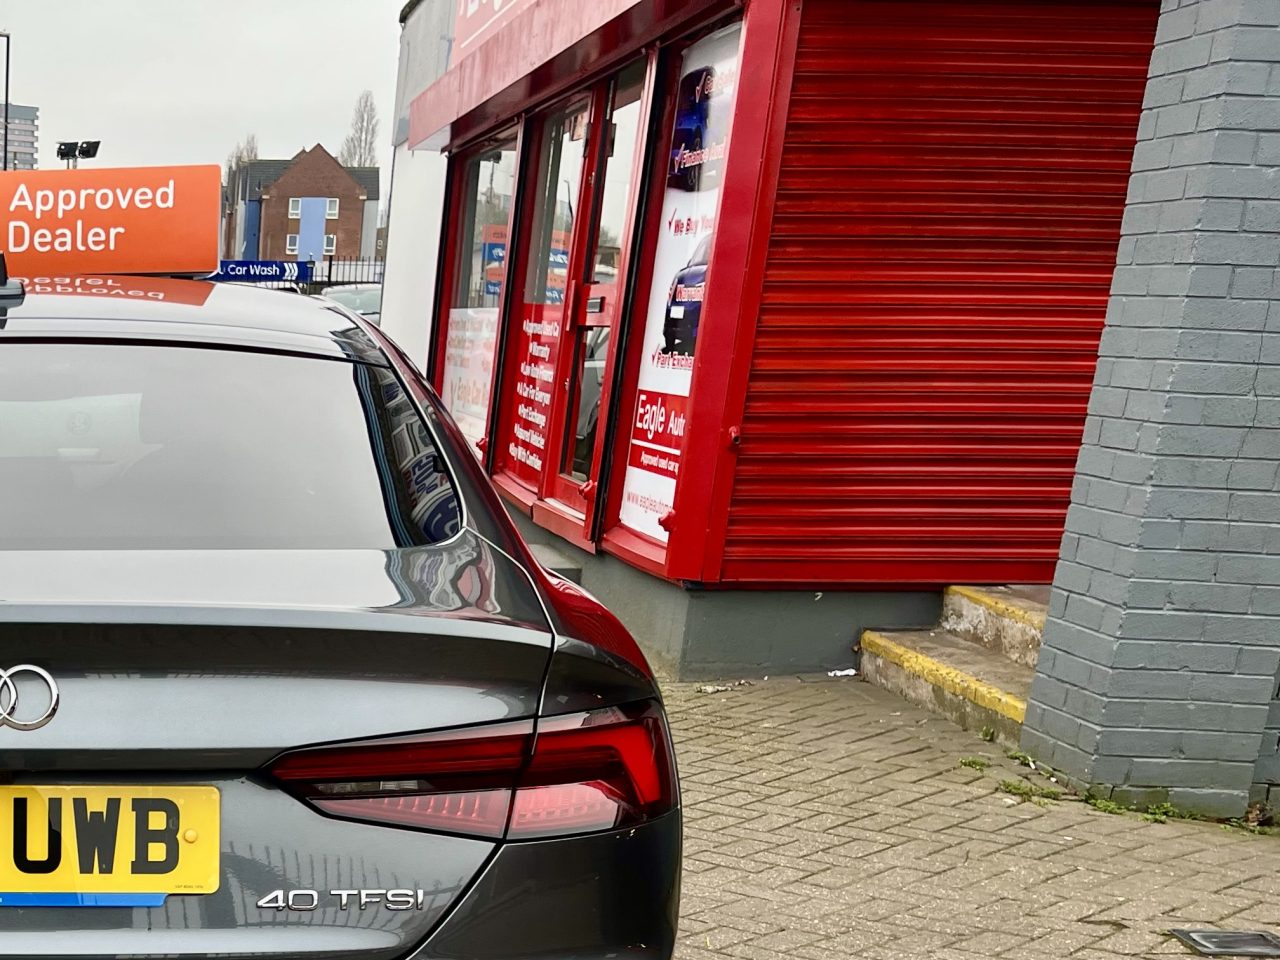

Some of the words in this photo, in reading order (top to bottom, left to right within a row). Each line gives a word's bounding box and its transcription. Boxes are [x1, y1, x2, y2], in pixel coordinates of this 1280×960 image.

[9, 179, 175, 219] Approved
[8, 220, 126, 253] Dealer
[674, 219, 684, 235] We
[227, 264, 248, 275] Car
[249, 264, 280, 276] Wash
[656, 351, 671, 368] Part
[636, 394, 665, 440] Eagle
[12, 796, 181, 875] UWB
[256, 889, 319, 912] 40
[329, 889, 425, 912] TFSI
